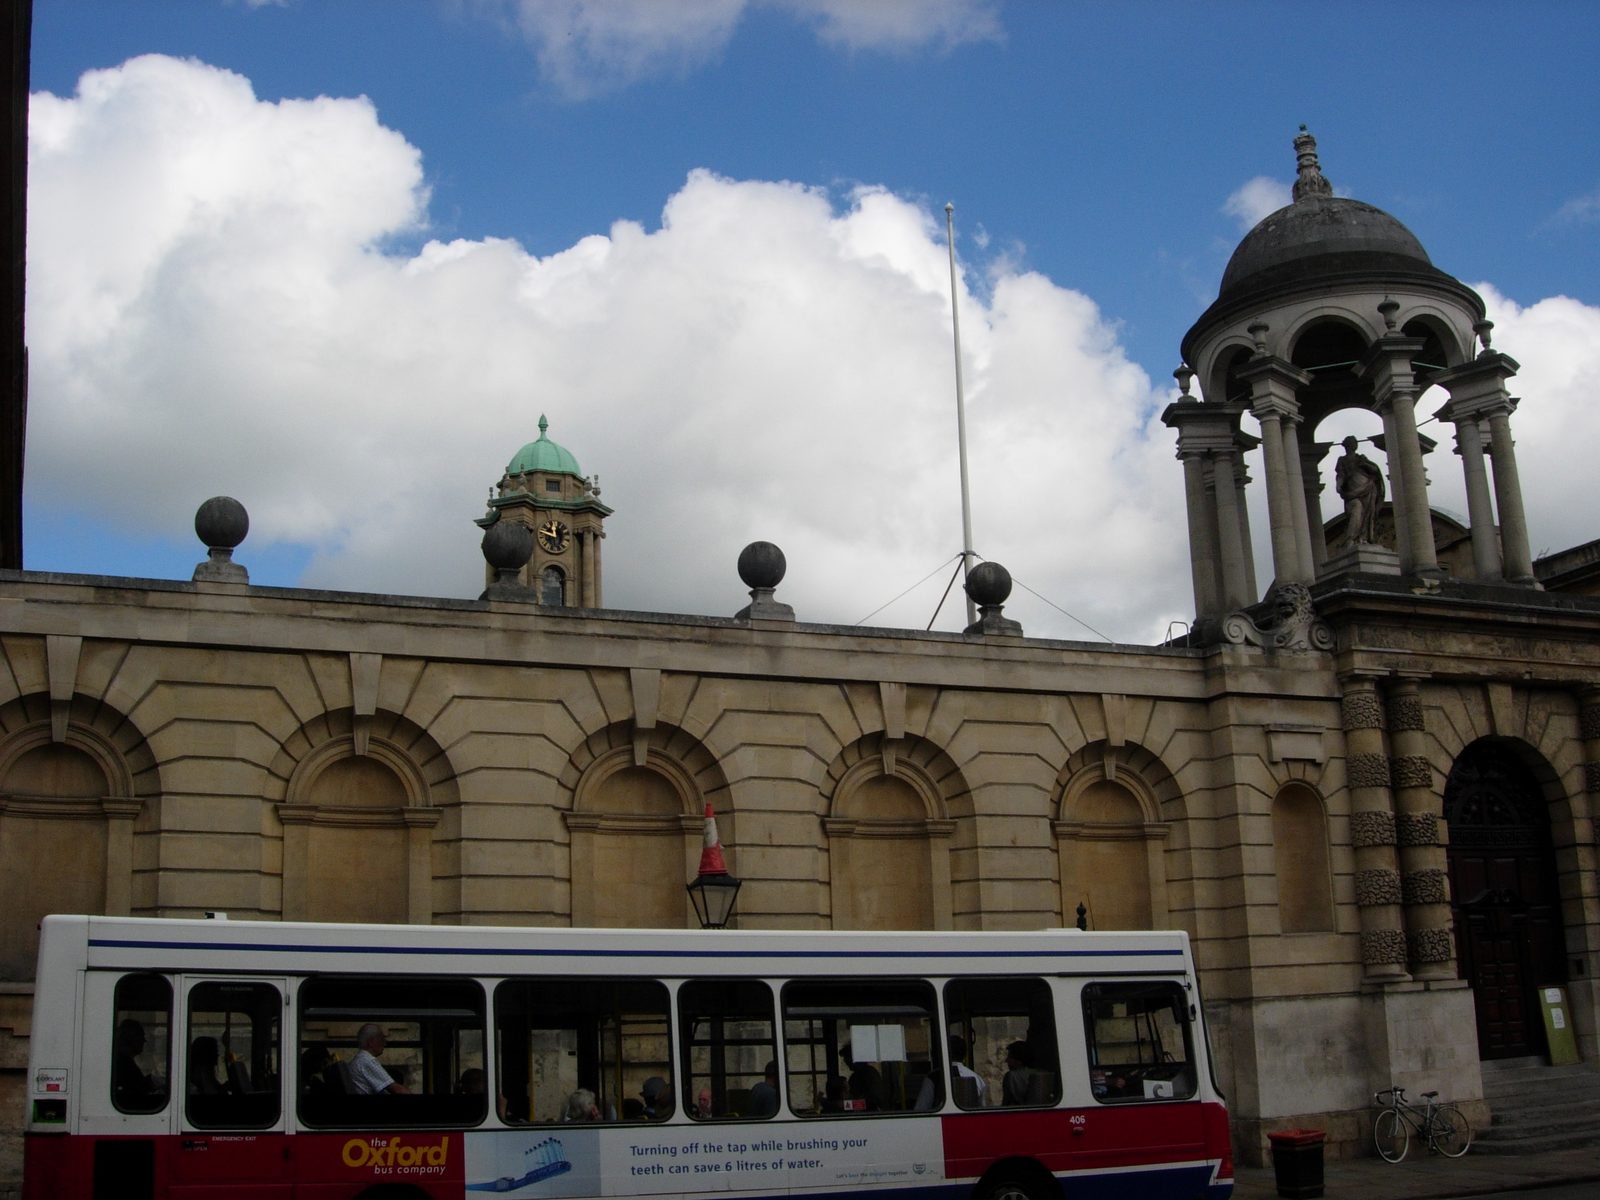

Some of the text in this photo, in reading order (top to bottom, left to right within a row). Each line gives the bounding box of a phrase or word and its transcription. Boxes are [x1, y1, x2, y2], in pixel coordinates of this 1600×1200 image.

[1069, 1115, 1086, 1124] 406
[371, 1138, 387, 1147] the
[630, 1138, 868, 1157] Turning off the tap while brushing your
[342, 1136, 449, 1167] Oxford
[374, 1165, 446, 1175] bus company
[631, 1159, 824, 1175] teeth can save 6 litres of water.
